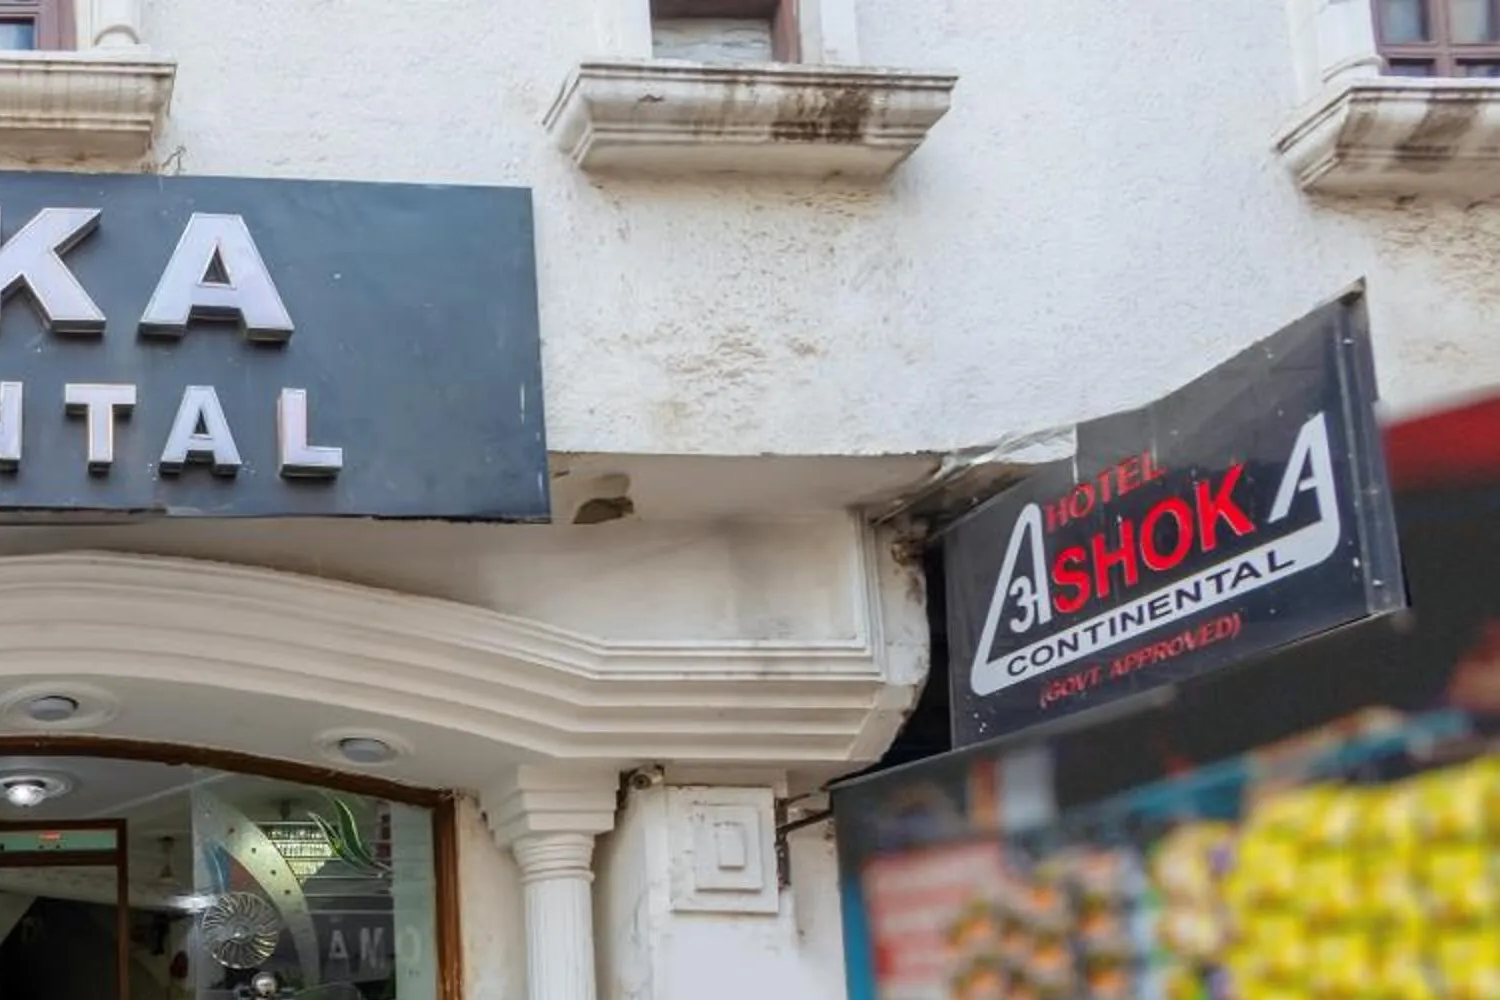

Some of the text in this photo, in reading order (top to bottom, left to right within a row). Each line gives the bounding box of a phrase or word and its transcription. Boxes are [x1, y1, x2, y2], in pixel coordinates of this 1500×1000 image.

[1045, 448, 1168, 534] HOTEL
[1006, 549, 1296, 678] CONTINENTAL
[1108, 610, 1242, 682] APPROVED)
